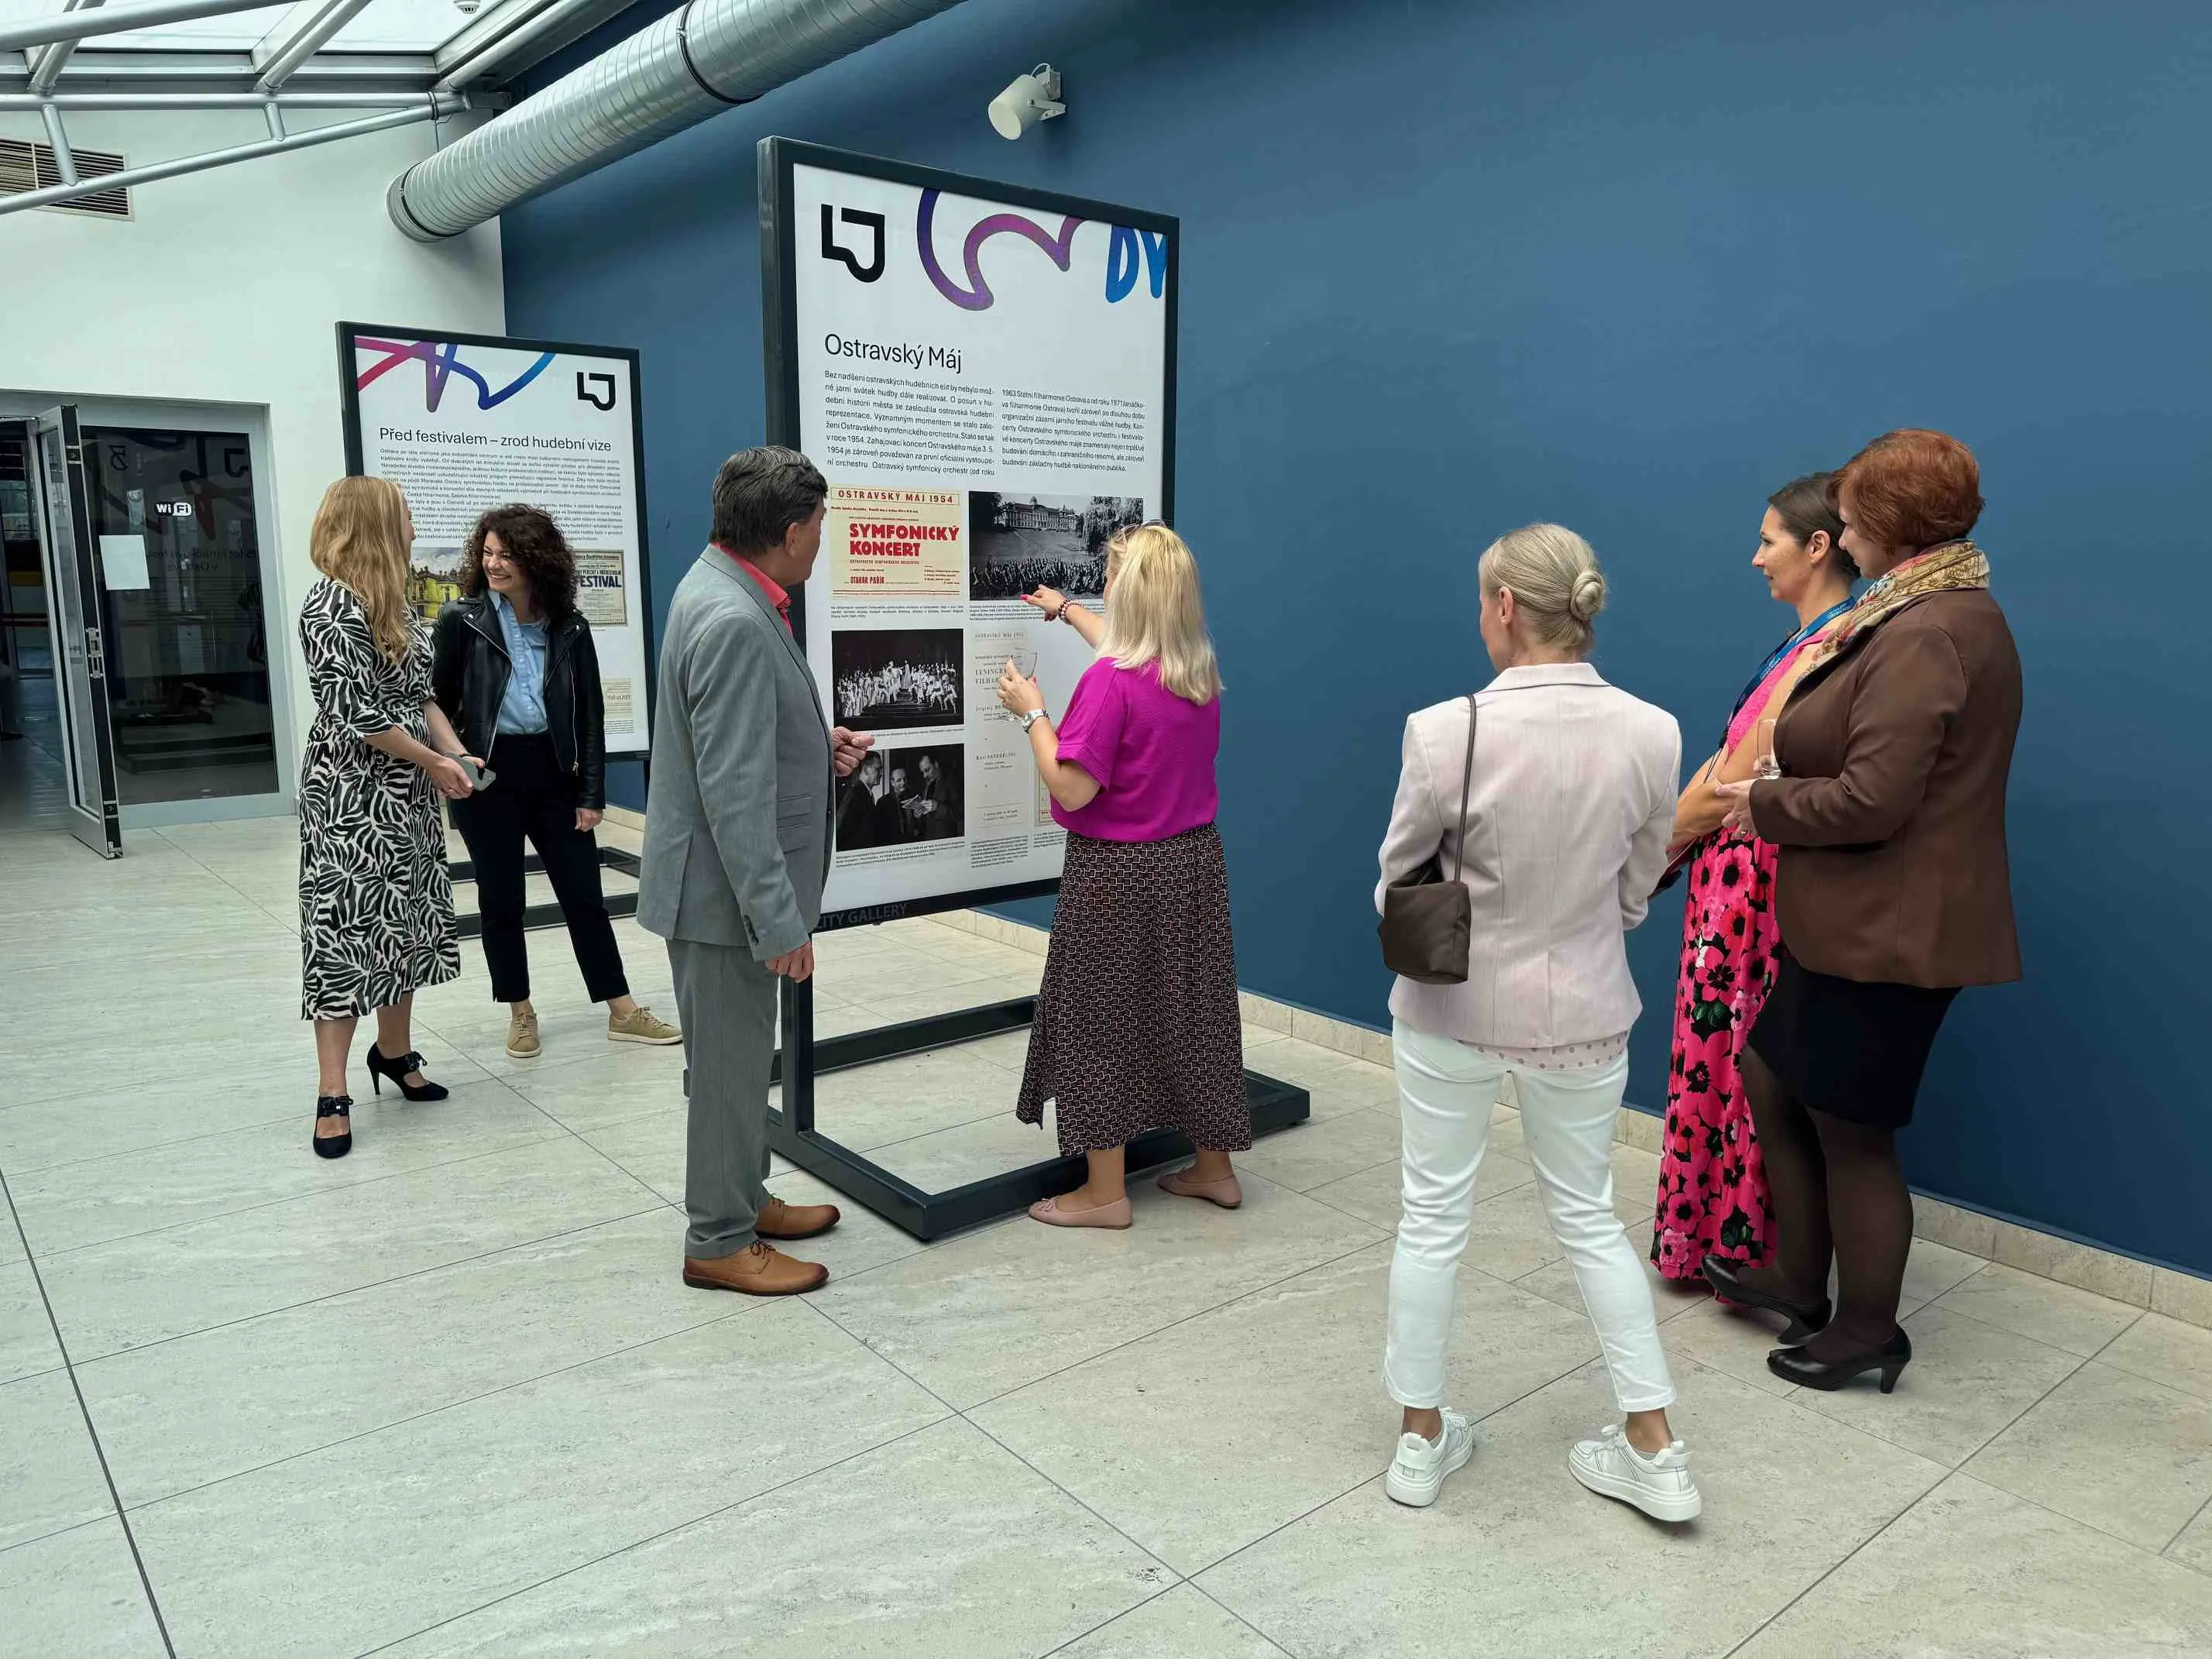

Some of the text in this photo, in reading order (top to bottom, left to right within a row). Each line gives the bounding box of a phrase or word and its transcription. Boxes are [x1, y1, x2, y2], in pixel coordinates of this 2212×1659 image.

[825, 333, 962, 374] Ostravský Máj
[380, 428, 413, 442] Před
[416, 431, 487, 445] festivalem
[501, 437, 529, 447] zrod
[533, 438, 585, 450] hudební
[588, 441, 611, 451] vize
[838, 490, 900, 501] OSTRAVSKÝ
[905, 493, 925, 502] MÁJ
[849, 523, 959, 541] SYMFONICKÝ
[850, 541, 921, 556] KONCERT
[577, 575, 621, 587] ESTIVAL
[848, 903, 907, 924] GALLERY
